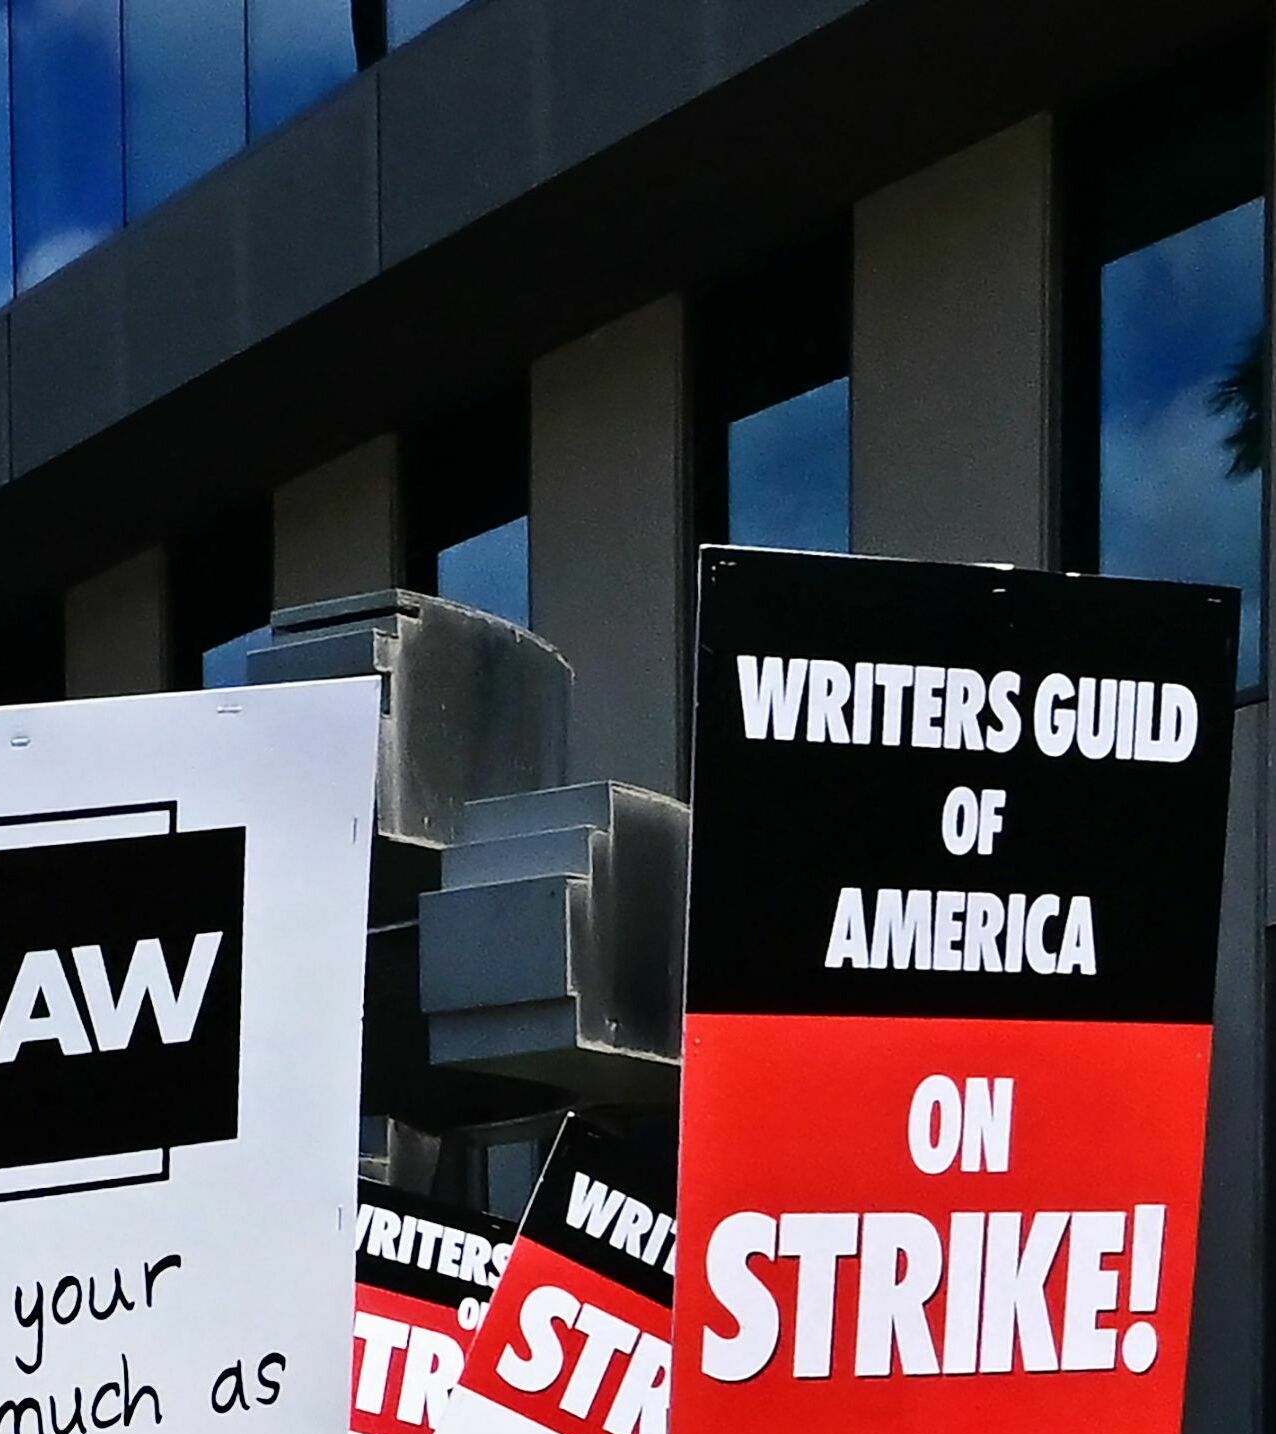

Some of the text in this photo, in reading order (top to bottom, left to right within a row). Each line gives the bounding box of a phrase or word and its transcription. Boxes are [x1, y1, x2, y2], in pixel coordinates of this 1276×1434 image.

[737, 655, 1198, 762] WRITERS GUILD
[942, 787, 1006, 855] OF
[825, 888, 1096, 975] AMERICA
[909, 1075, 1013, 1174] ON
[15, 1254, 182, 1375] your
[457, 1296, 490, 1331] O
[702, 1204, 1165, 1381] STRIKE!
[212, 1353, 286, 1413] as
